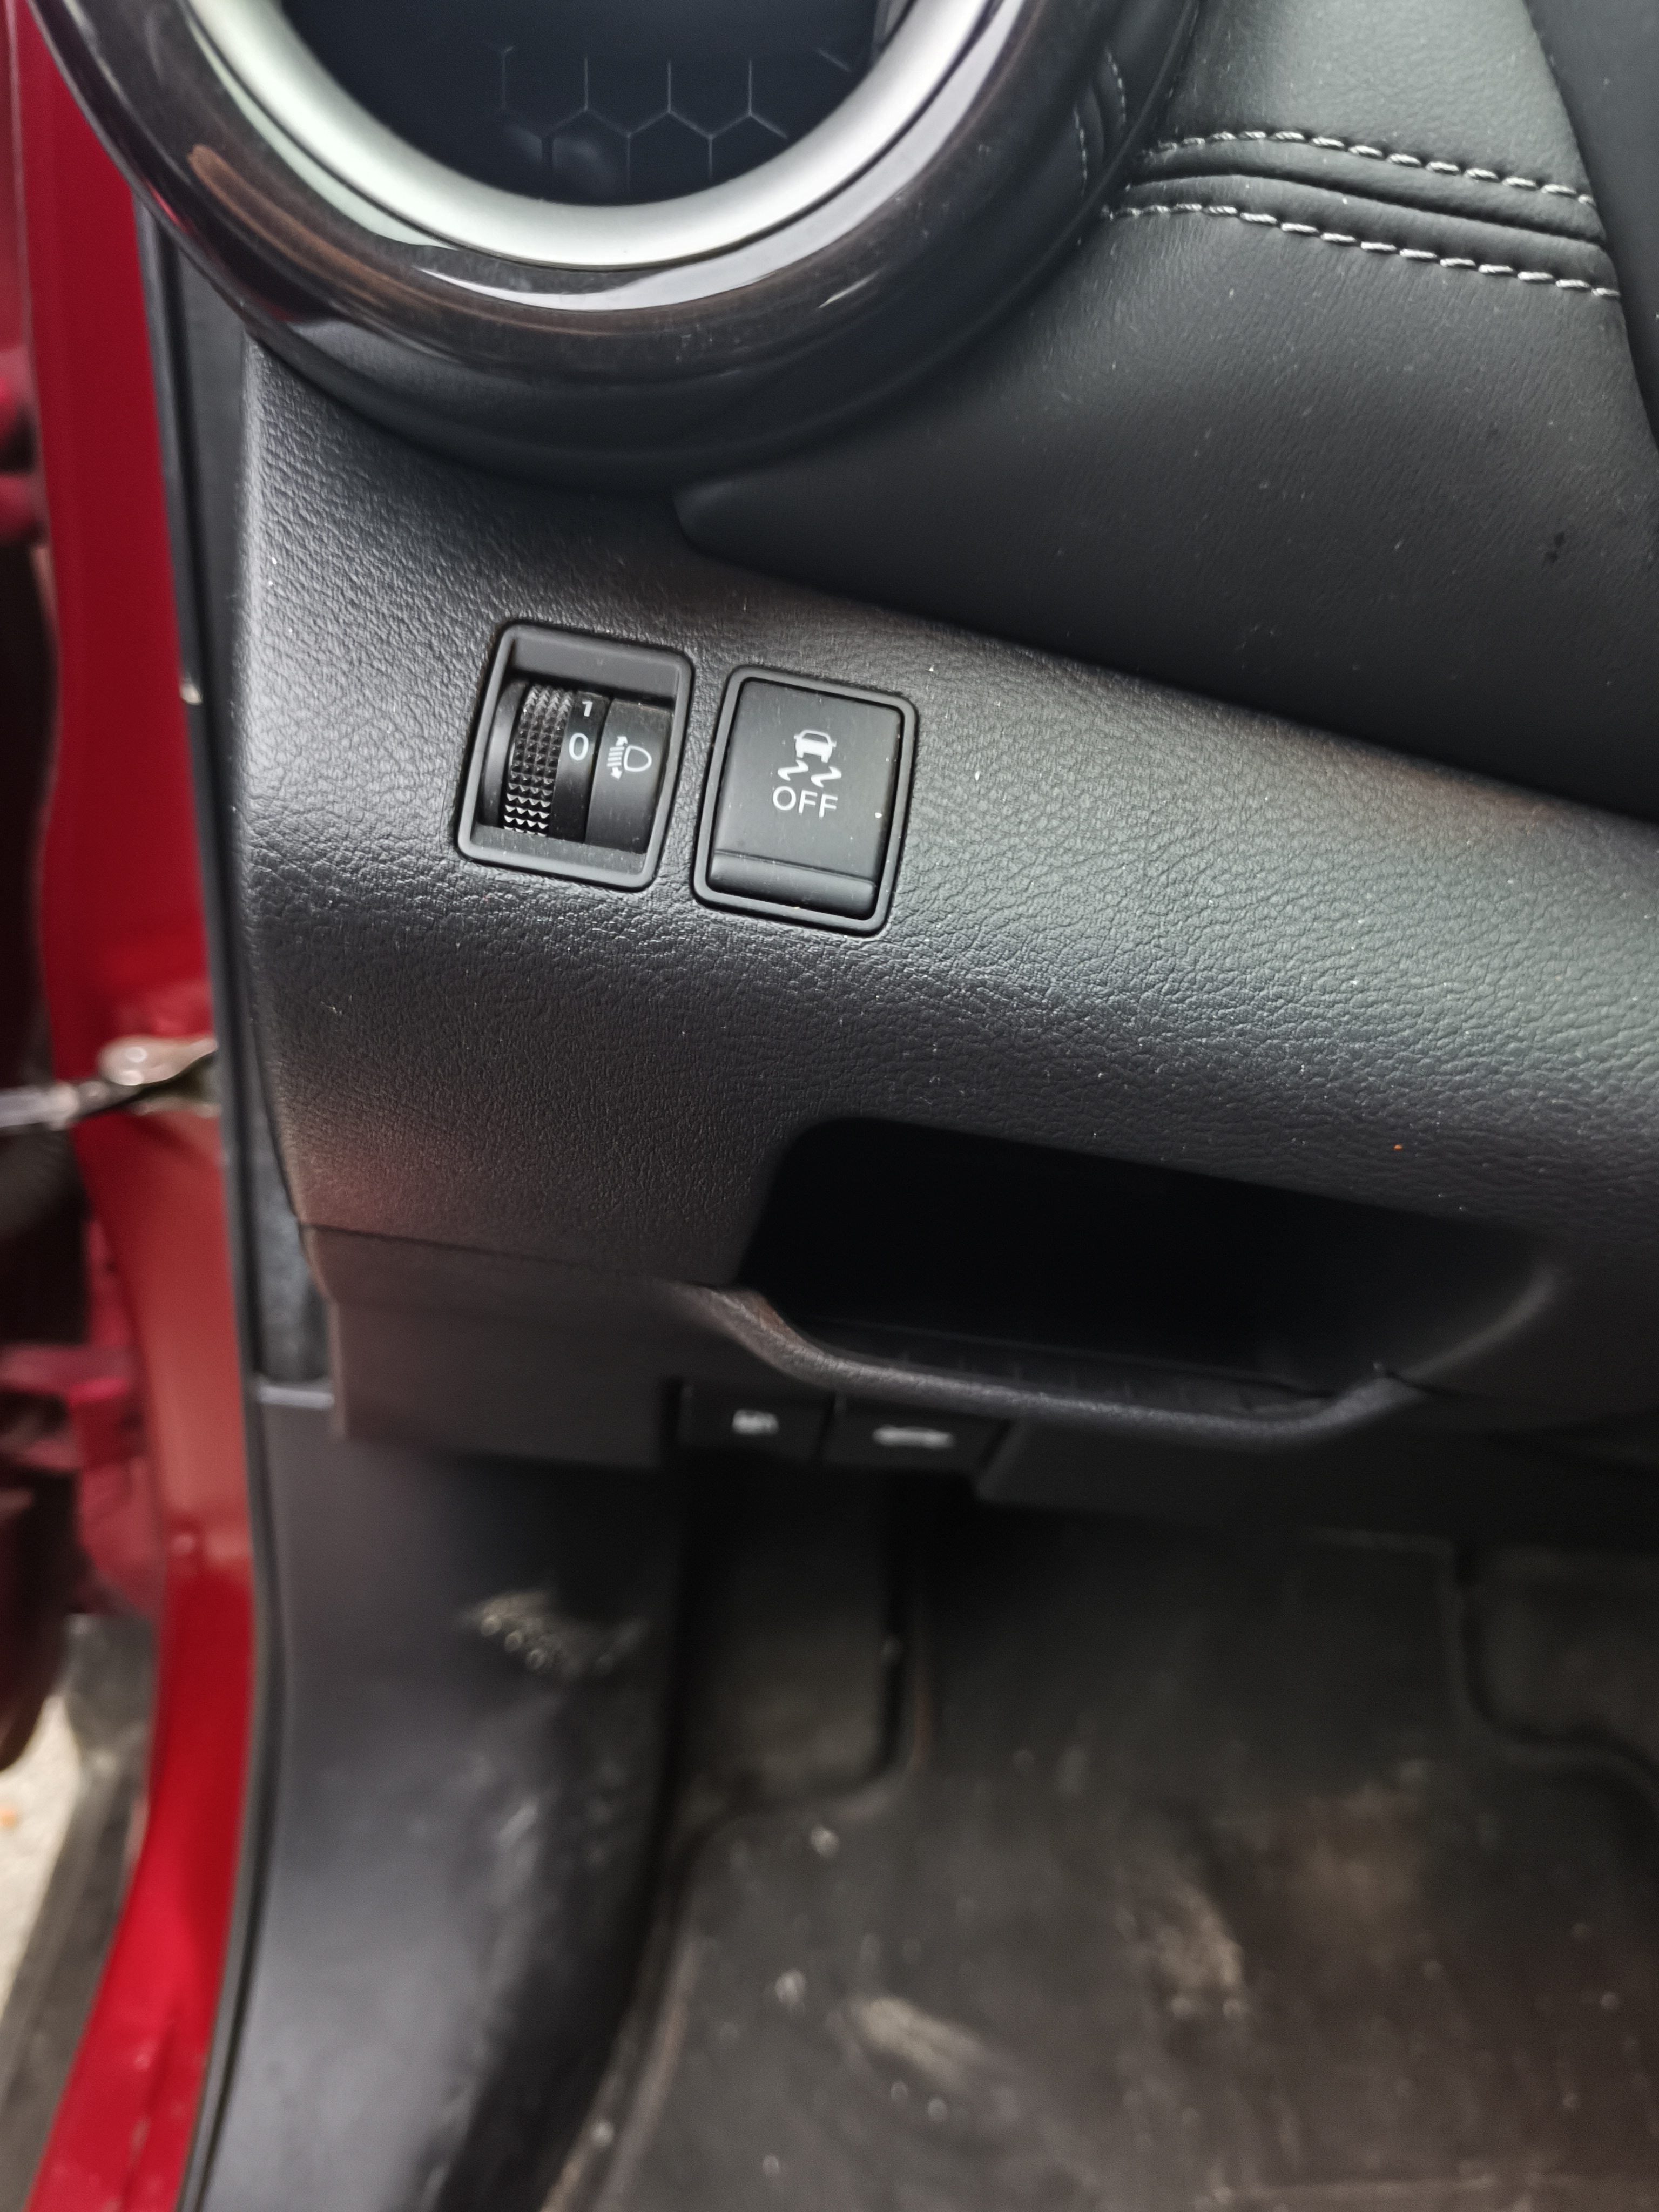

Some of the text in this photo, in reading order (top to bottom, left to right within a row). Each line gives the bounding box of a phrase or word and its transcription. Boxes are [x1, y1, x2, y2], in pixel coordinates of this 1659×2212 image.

[582, 700, 593, 717] 1
[569, 732, 589, 761] 0
[772, 786, 838, 818] OFF
